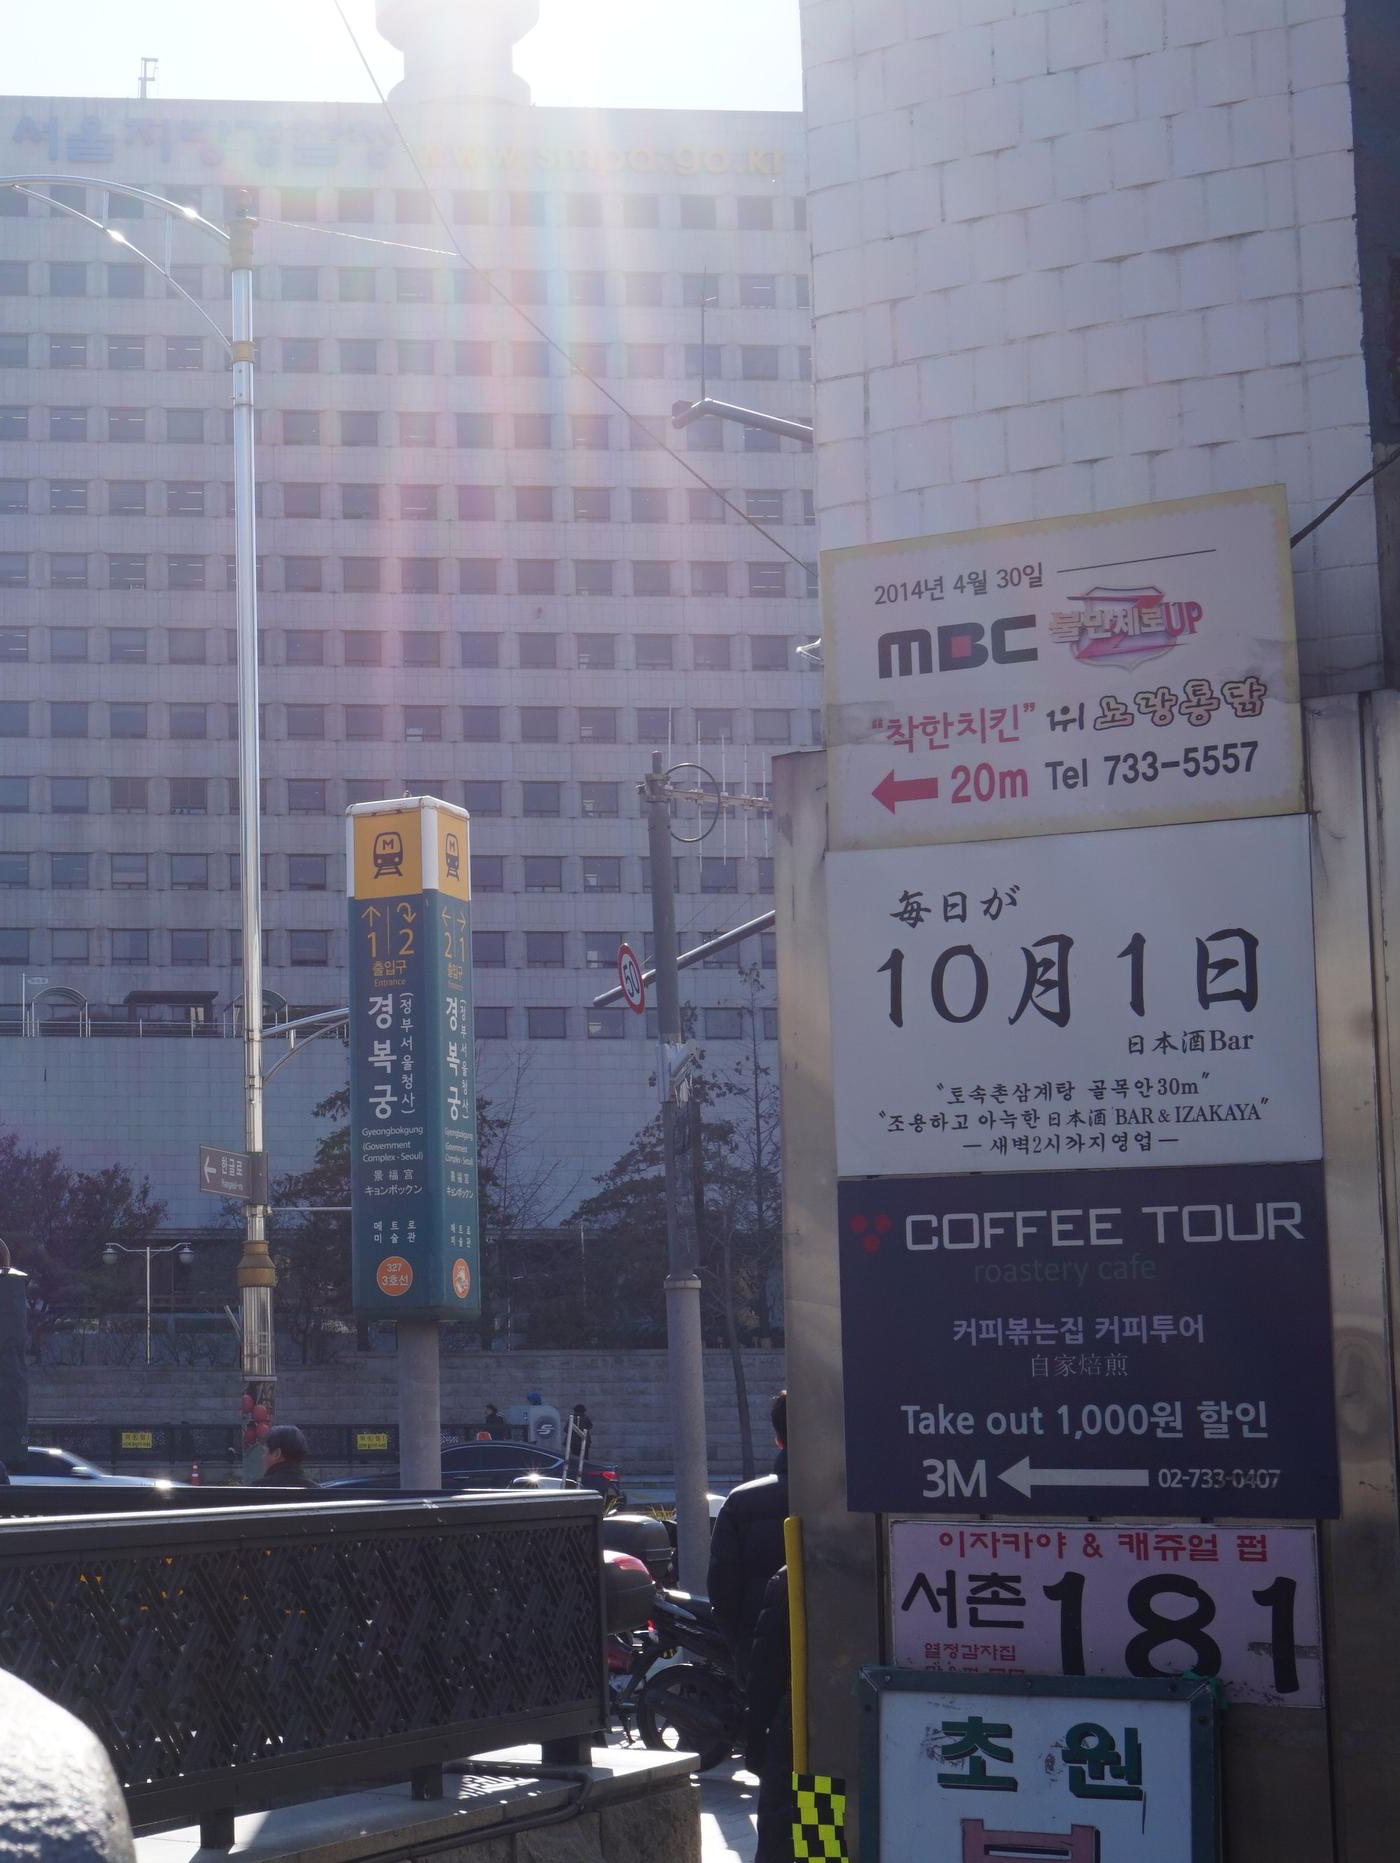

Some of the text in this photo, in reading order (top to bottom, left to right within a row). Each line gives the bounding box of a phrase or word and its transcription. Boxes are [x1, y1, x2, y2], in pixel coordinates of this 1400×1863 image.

[874, 562, 1043, 605] 2014년 4월 30일
[1046, 703, 1084, 733] 1위
[951, 740, 1259, 803] 20m Tel 733-5557
[367, 929, 415, 957] 1 2
[372, 959, 407, 977] 출입구
[374, 978, 406, 988] Entrance
[623, 961, 640, 997] 50
[368, 994, 398, 1119] 경복궁
[362, 1126, 423, 1137] Gyeongbokgung
[977, 1111, 1041, 1130] 아늑한
[1158, 1109, 1171, 1123] &
[363, 1141, 411, 1152] (Government
[905, 1201, 1307, 1251] COFFEE TOUR
[387, 1263, 402, 1272] 327
[974, 1252, 1157, 1288] roastery cafe
[953, 1314, 1205, 1346] 커피볶는집 커피투어
[901, 1400, 1268, 1440] Take out 1,000원 할인
[922, 1458, 1281, 1498] 3M 02-733-0407
[938, 1530, 1067, 1561] 이자카야
[1082, 1534, 1103, 1559] &
[923, 1642, 1017, 1662] 열정감자집
